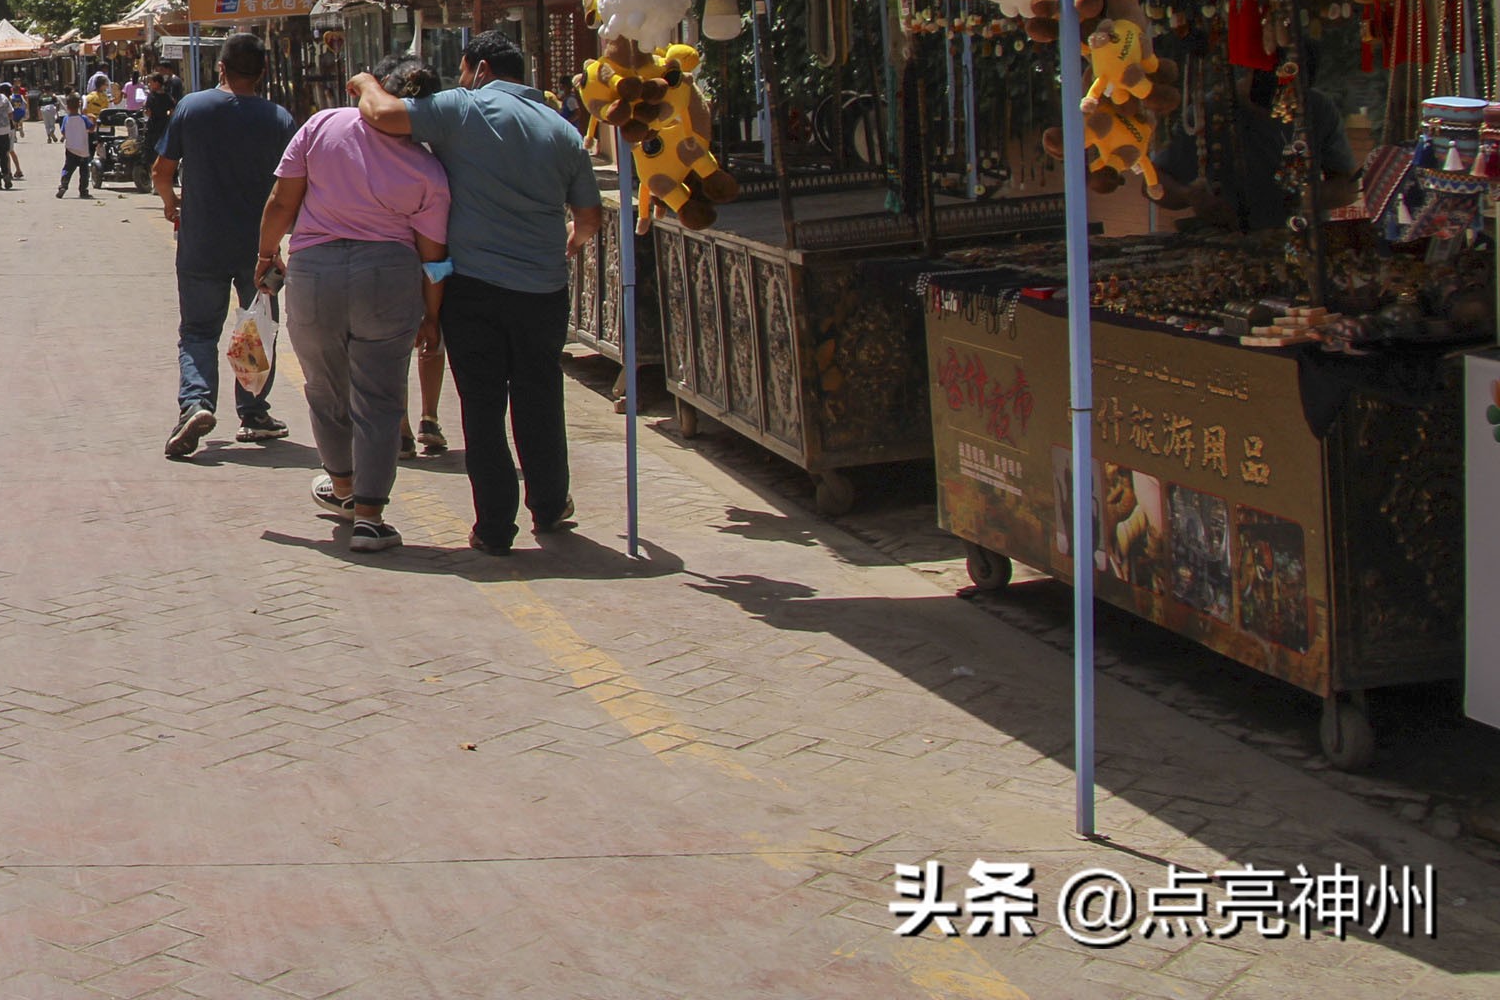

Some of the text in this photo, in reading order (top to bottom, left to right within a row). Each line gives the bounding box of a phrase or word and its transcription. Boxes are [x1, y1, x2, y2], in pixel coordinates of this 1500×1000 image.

[1067, 396, 1272, 485] 什旅游用品
